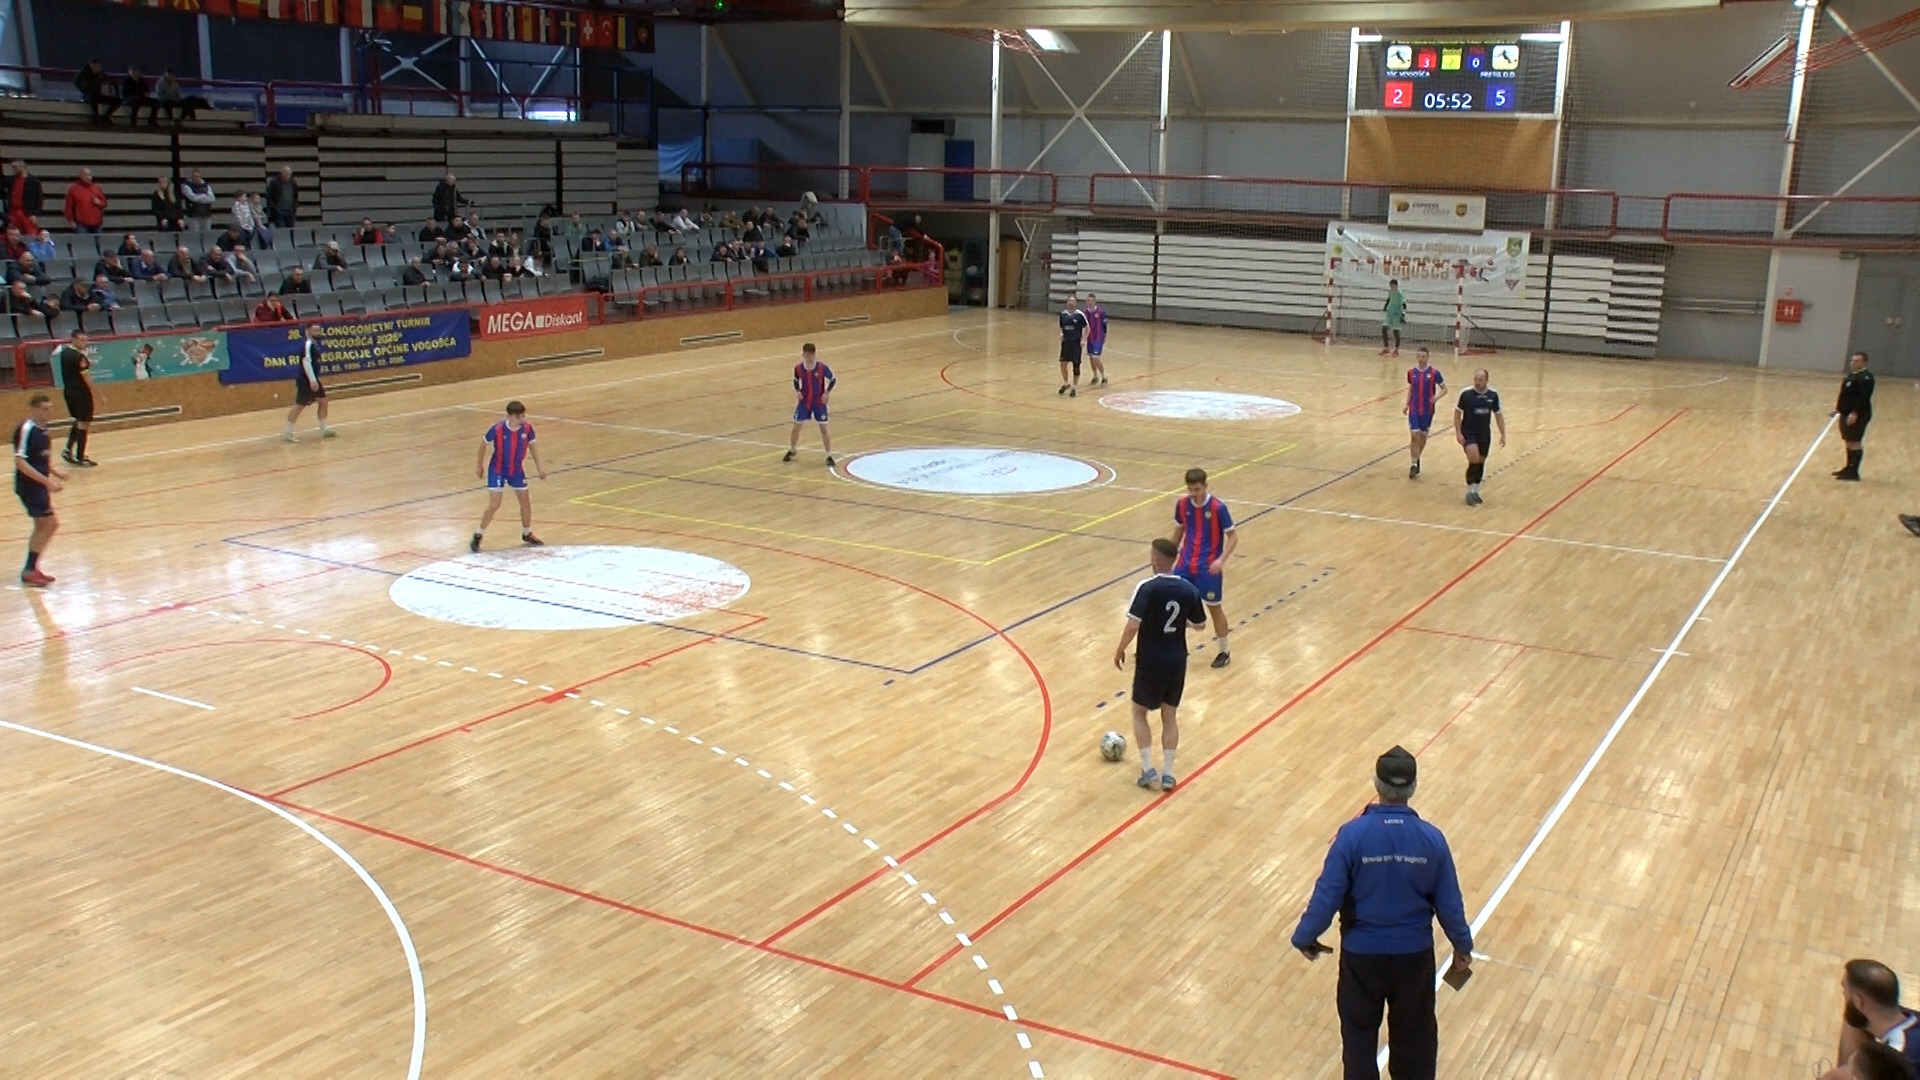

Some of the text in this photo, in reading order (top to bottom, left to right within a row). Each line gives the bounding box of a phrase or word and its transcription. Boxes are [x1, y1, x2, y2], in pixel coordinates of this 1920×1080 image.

[1472, 57, 1480, 68] 0
[1392, 89, 1403, 104] 2
[1424, 93, 1473, 109] 05:52
[1495, 89, 1506, 106] 5
[1784, 306, 1794, 317] H
[319, 321, 394, 336] LONOGOMETNI
[396, 317, 431, 328] TURNIR
[487, 311, 583, 334] MEGA Diskont
[264, 356, 287, 368] DAN
[1163, 600, 1180, 633] 2
